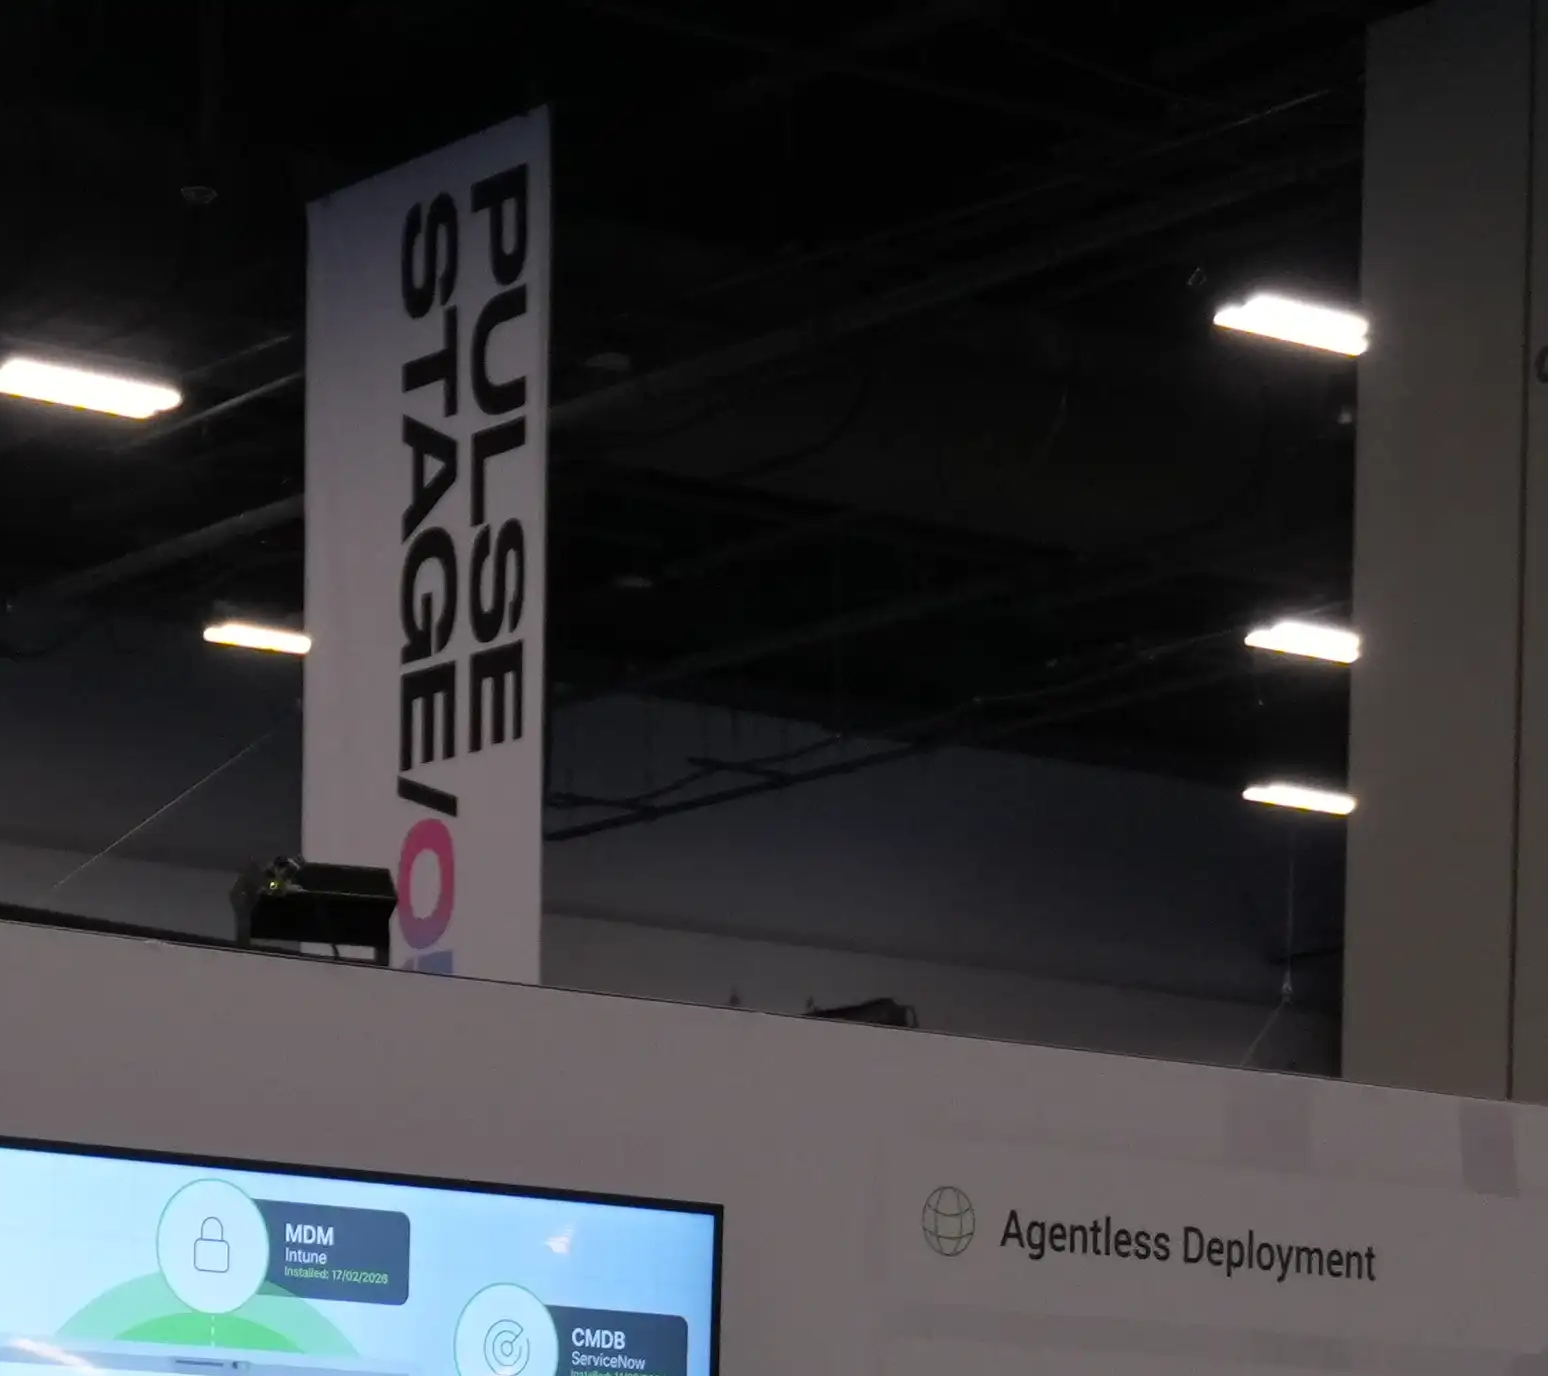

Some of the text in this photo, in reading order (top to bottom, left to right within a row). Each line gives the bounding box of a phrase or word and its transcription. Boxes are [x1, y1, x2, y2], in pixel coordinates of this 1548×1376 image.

[469, 162, 529, 752] PULSE
[285, 1223, 334, 1246] MDM
[1000, 1209, 1377, 1283] Agentless Deployment
[285, 1247, 327, 1265] Intune
[284, 1266, 329, 1281] Installed:
[571, 1327, 626, 1350] CMDB
[571, 1351, 646, 1371] ServiceNow
